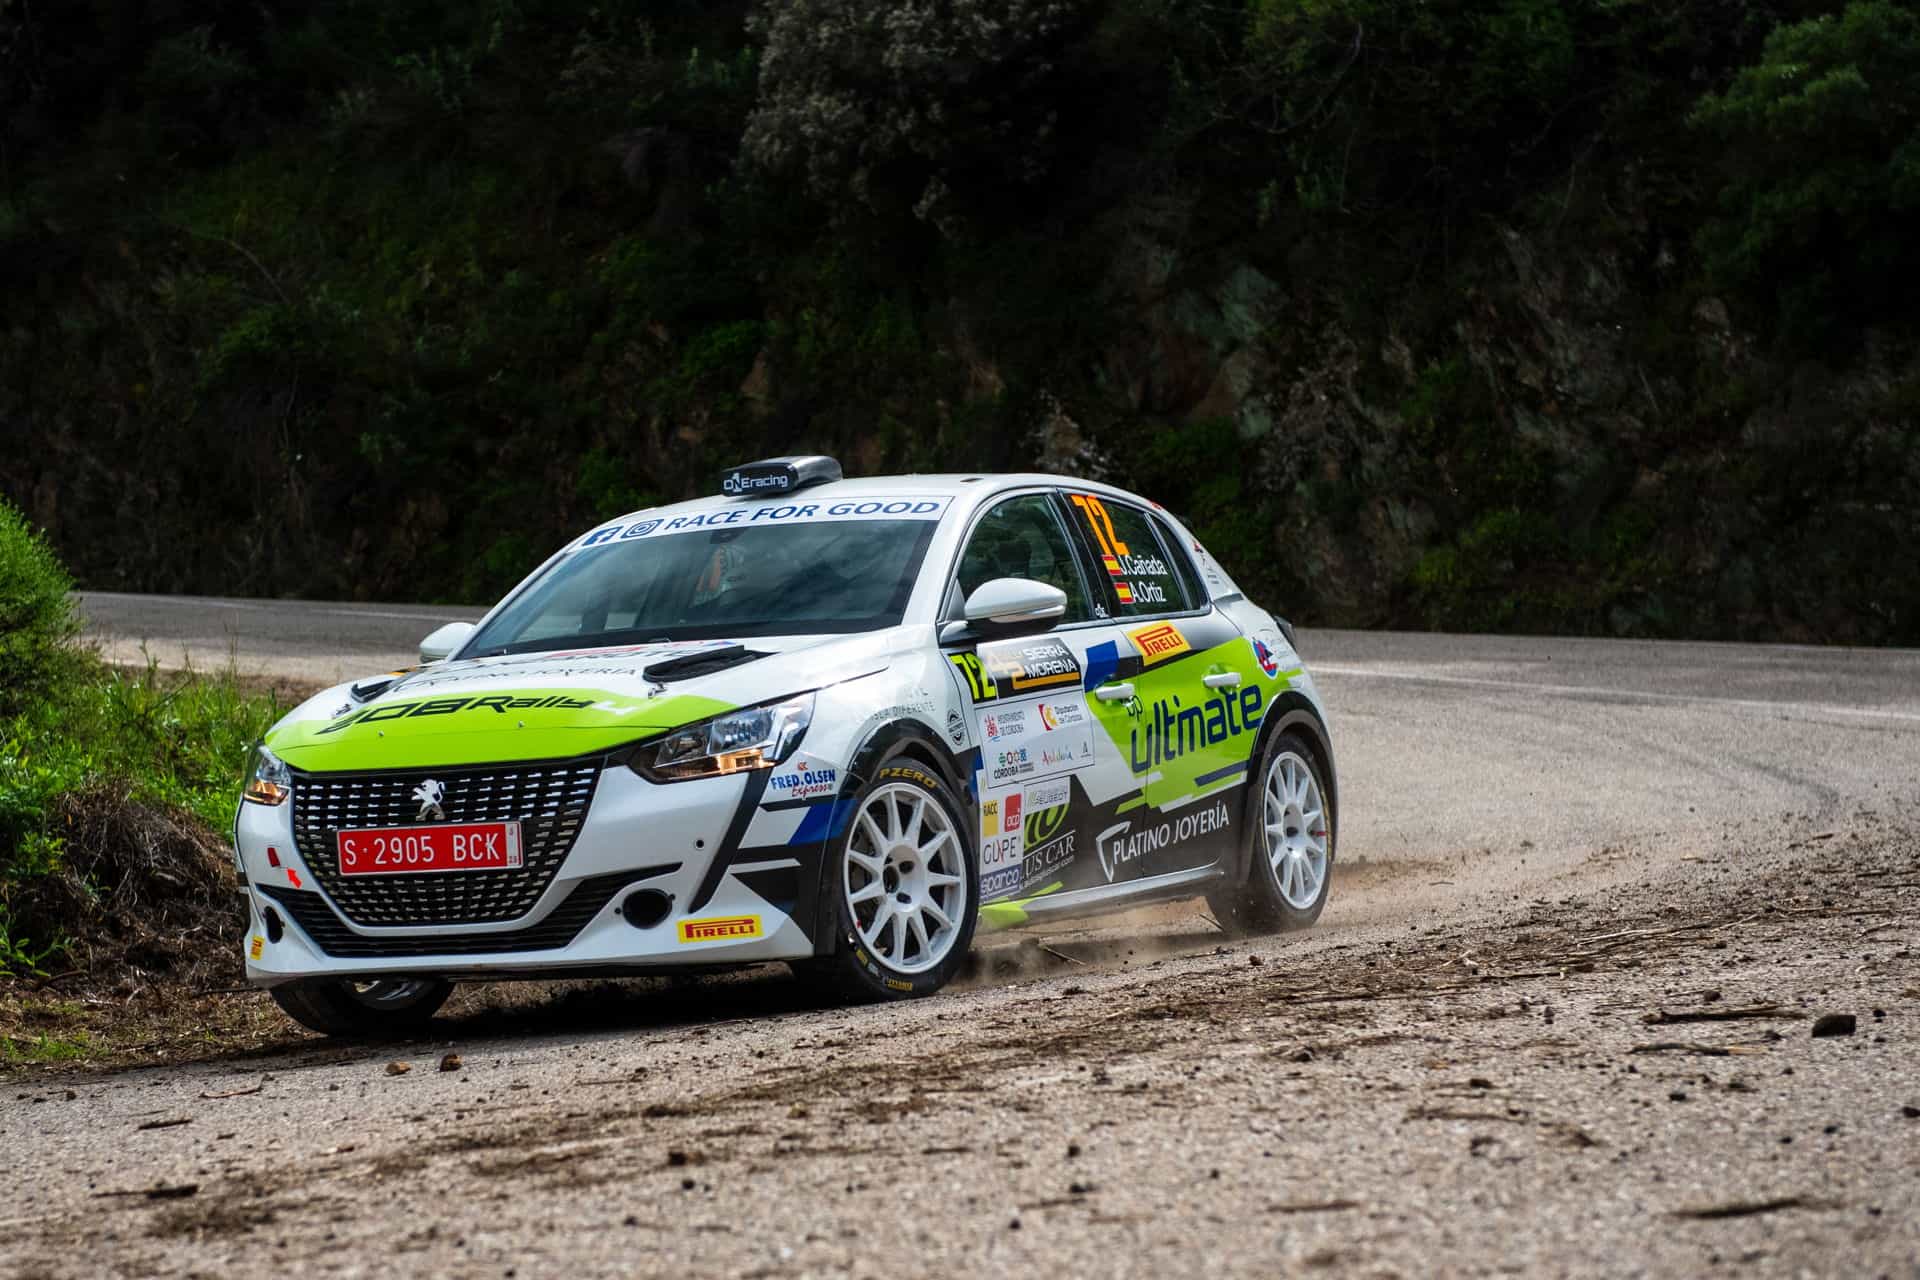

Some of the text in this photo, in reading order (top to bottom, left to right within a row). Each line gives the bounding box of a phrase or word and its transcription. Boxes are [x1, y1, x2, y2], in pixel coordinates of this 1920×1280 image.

[664, 501, 940, 531] RACE FOR GOOD
[1071, 494, 1130, 556] 72
[1022, 644, 1069, 661] SIERRA
[1136, 625, 1184, 656] PIRELLI
[1024, 658, 1078, 678] MORENA
[1131, 684, 1263, 774] ultimate
[453, 832, 499, 862] BCK
[1113, 800, 1230, 865] PLATINO JOYERÍA
[1046, 834, 1076, 864] CAR
[981, 868, 1019, 894] sparco
[685, 918, 755, 939] PIRELLI
